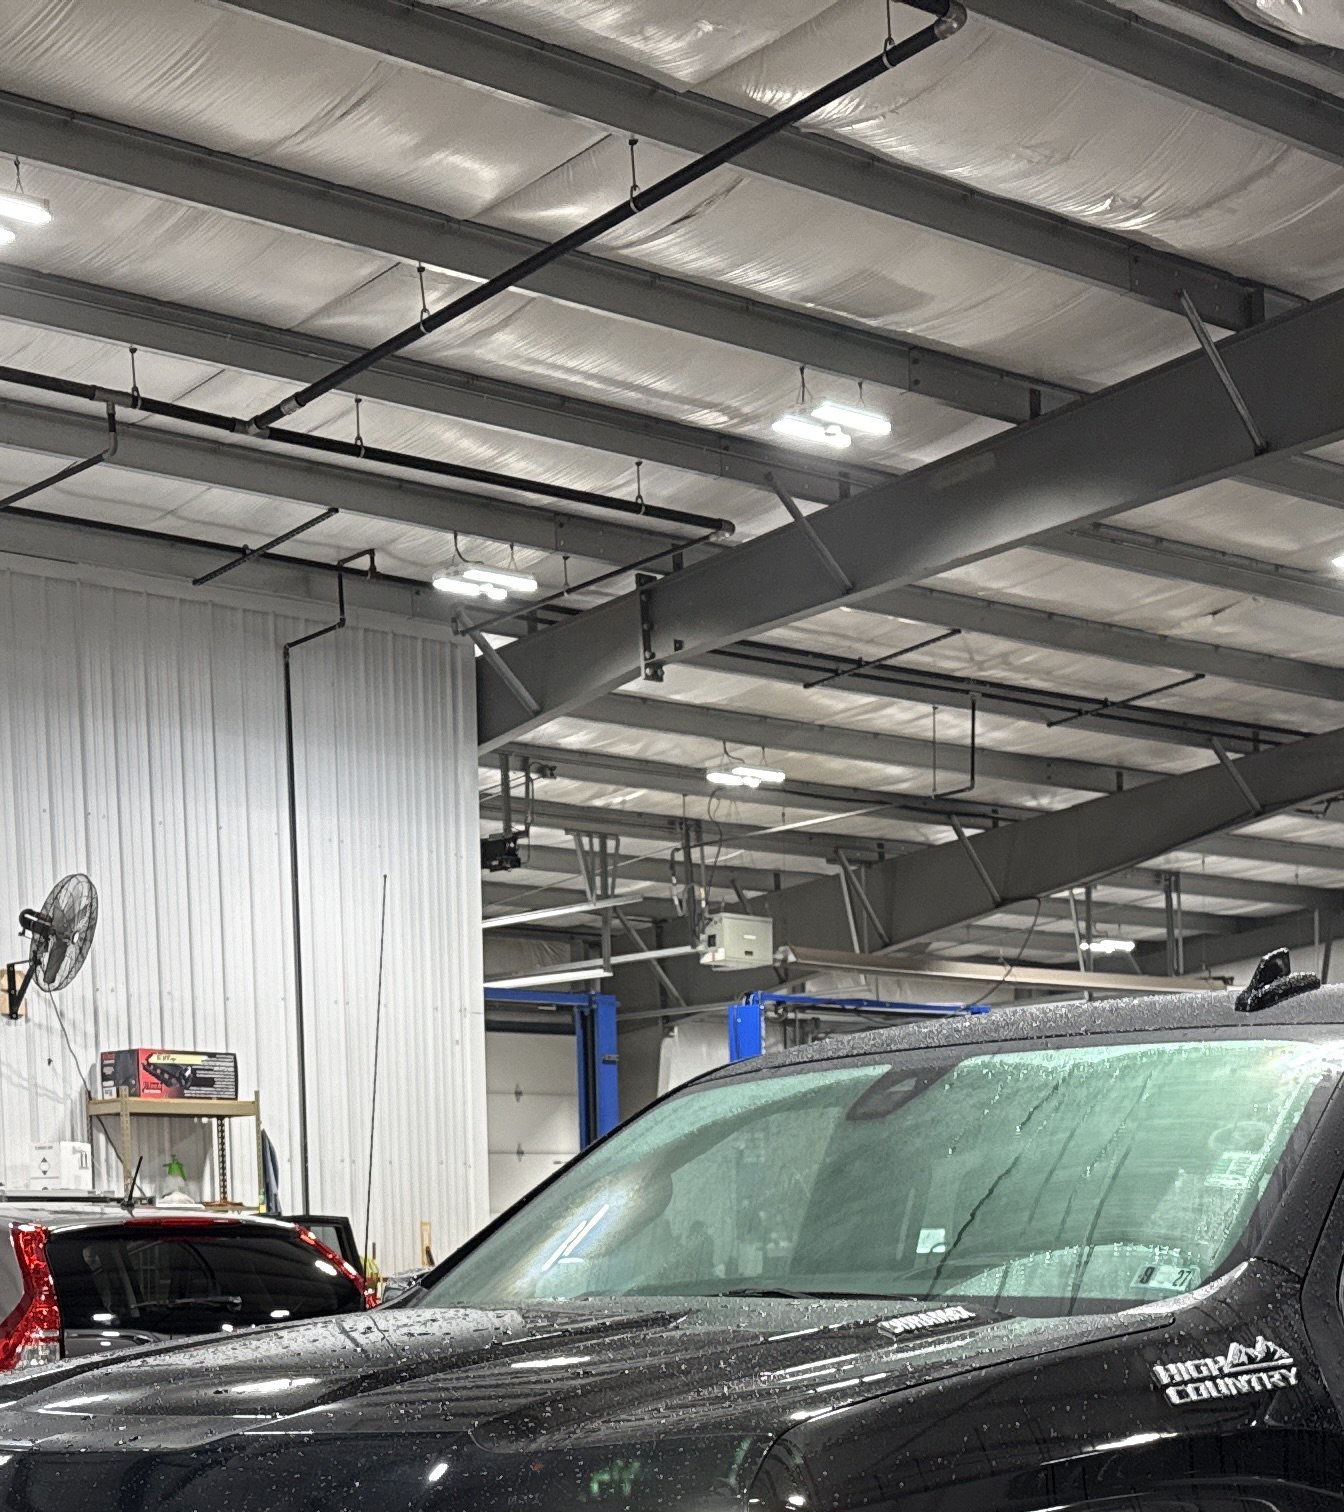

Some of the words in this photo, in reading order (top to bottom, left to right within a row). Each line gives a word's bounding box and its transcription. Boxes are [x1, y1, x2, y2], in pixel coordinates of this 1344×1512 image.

[1172, 1269, 1192, 1287] 27
[1152, 1353, 1231, 1386] HIGH
[1165, 1366, 1299, 1405] COUNTRY
